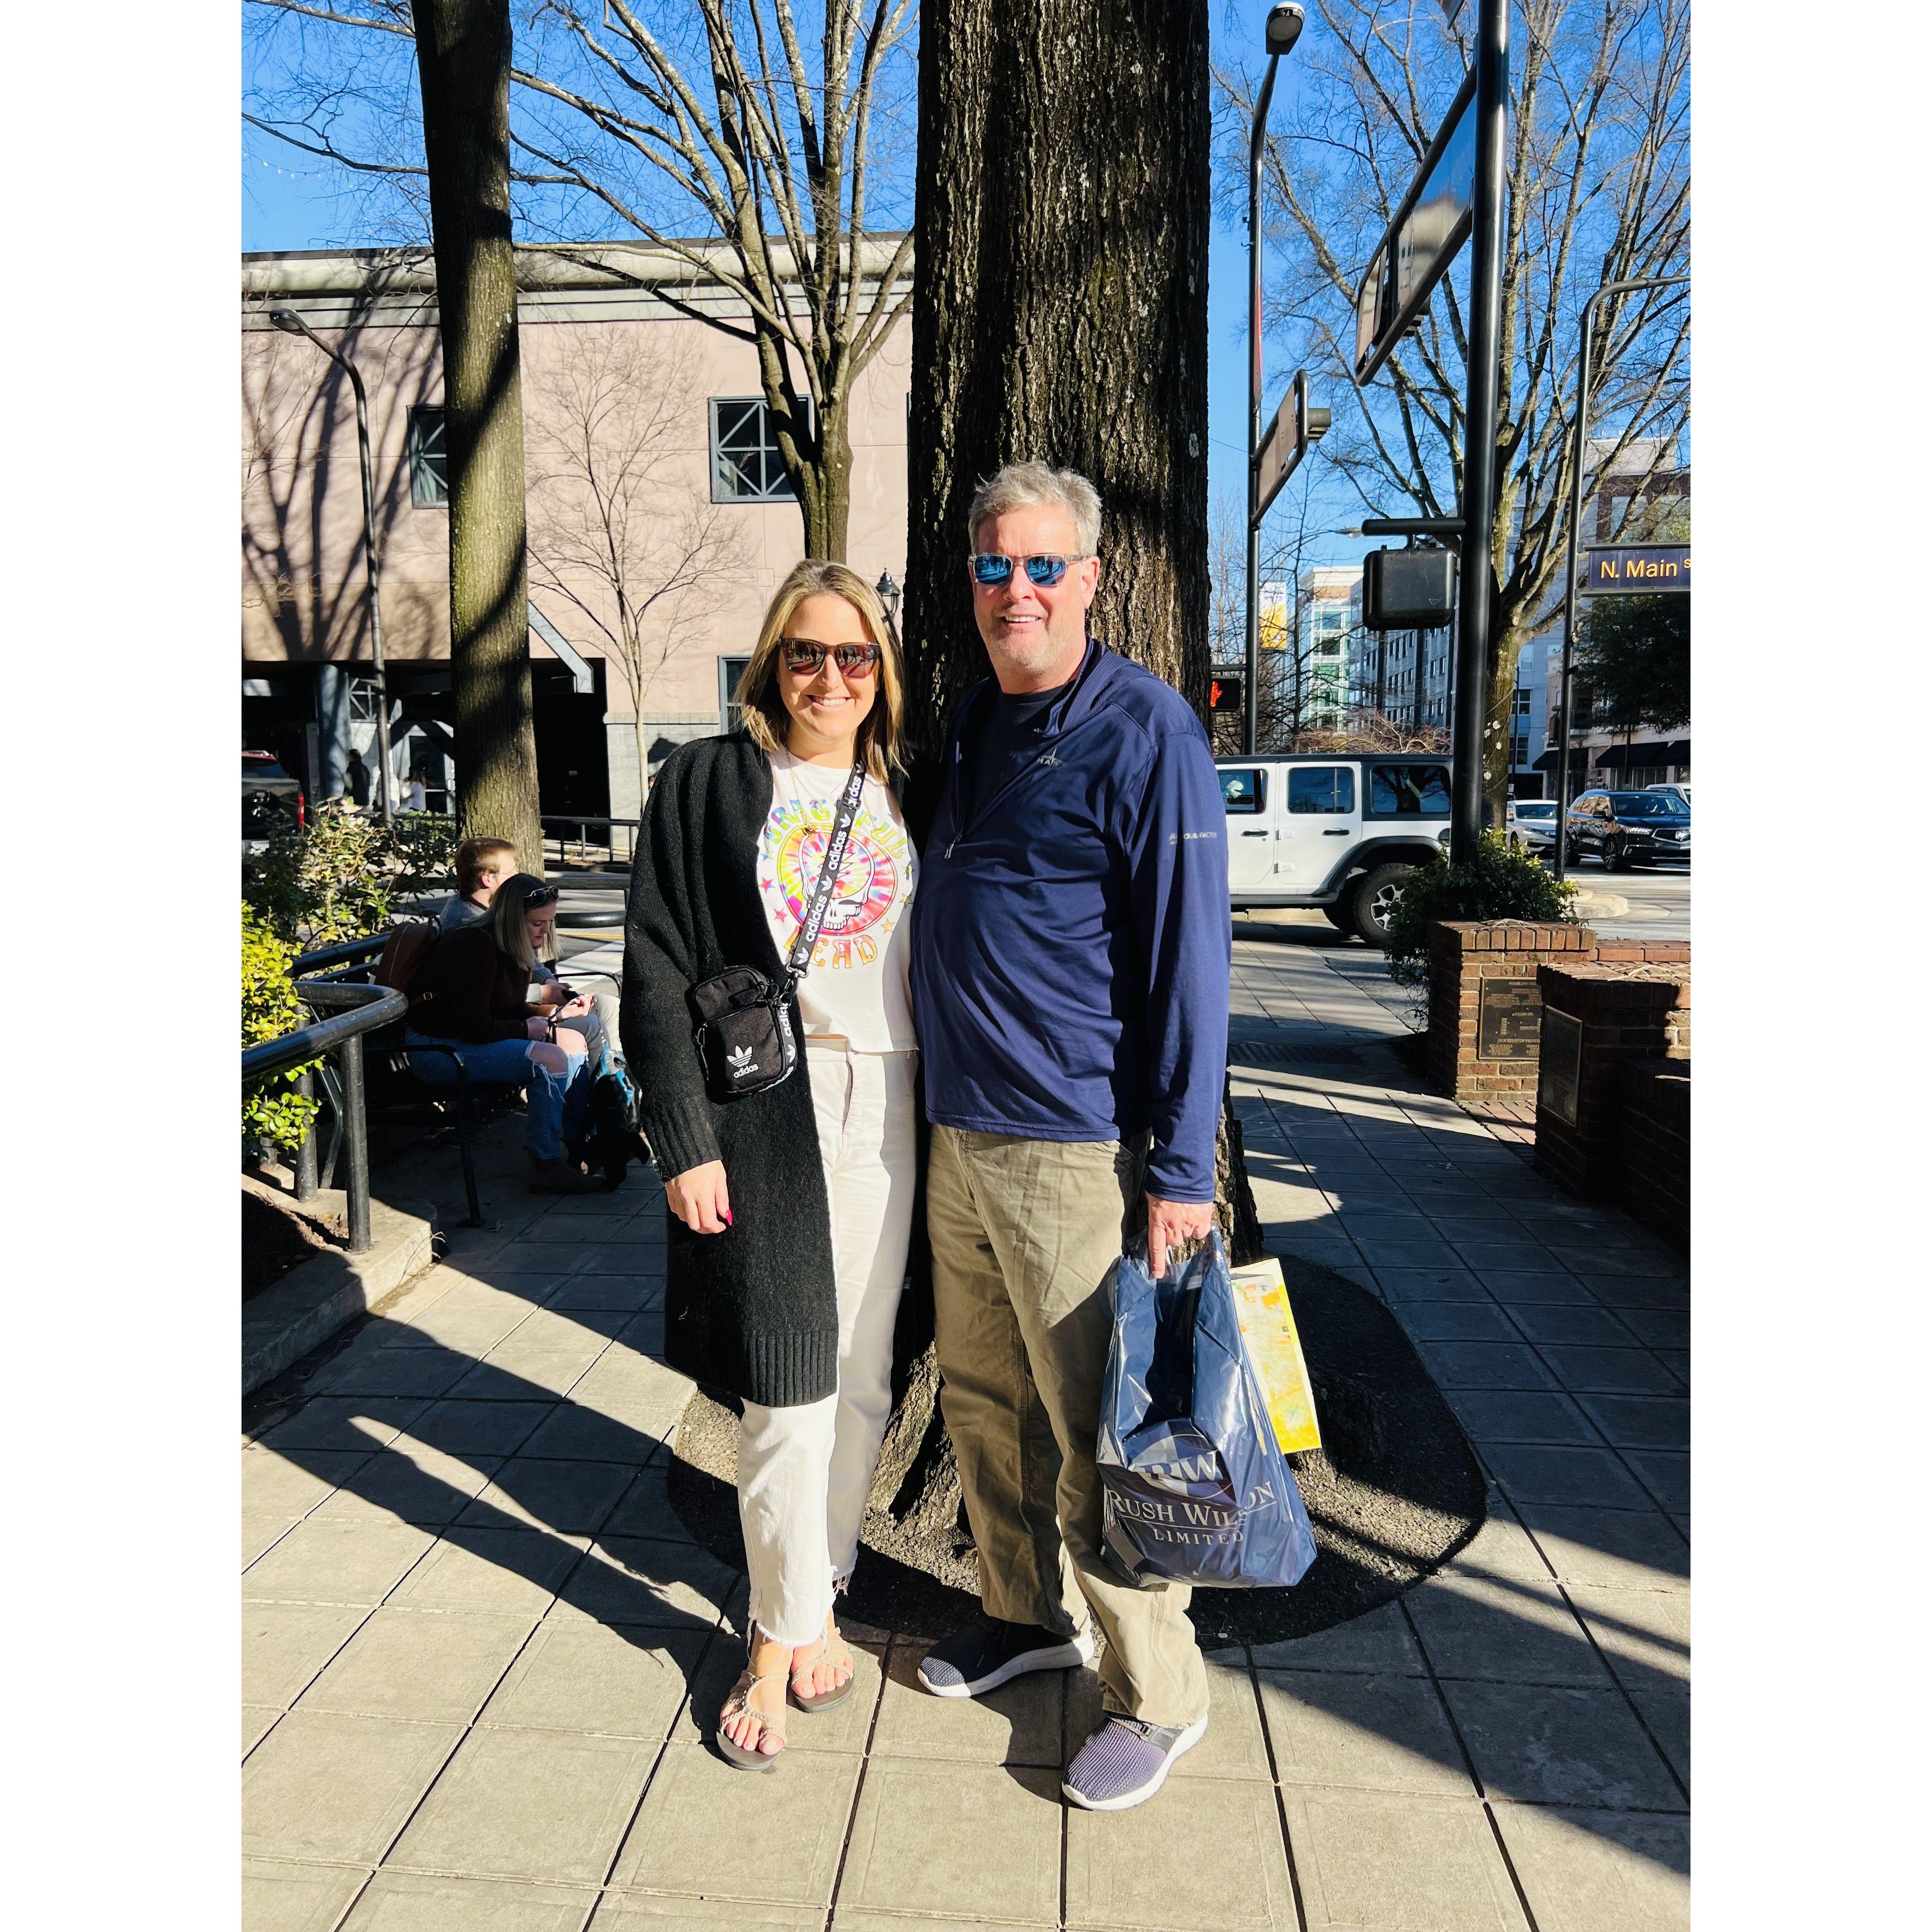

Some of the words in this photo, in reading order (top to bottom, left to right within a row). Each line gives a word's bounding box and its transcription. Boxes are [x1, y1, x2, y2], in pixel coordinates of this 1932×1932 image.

[1601, 561, 1619, 578] N.
[1626, 559, 1677, 578] Main
[828, 830, 847, 871] adidas
[805, 895, 827, 942] adidas
[733, 1063, 759, 1078] adidas
[1107, 1489, 1175, 1523] RUSH
[1153, 1528, 1244, 1546] LIMITED
